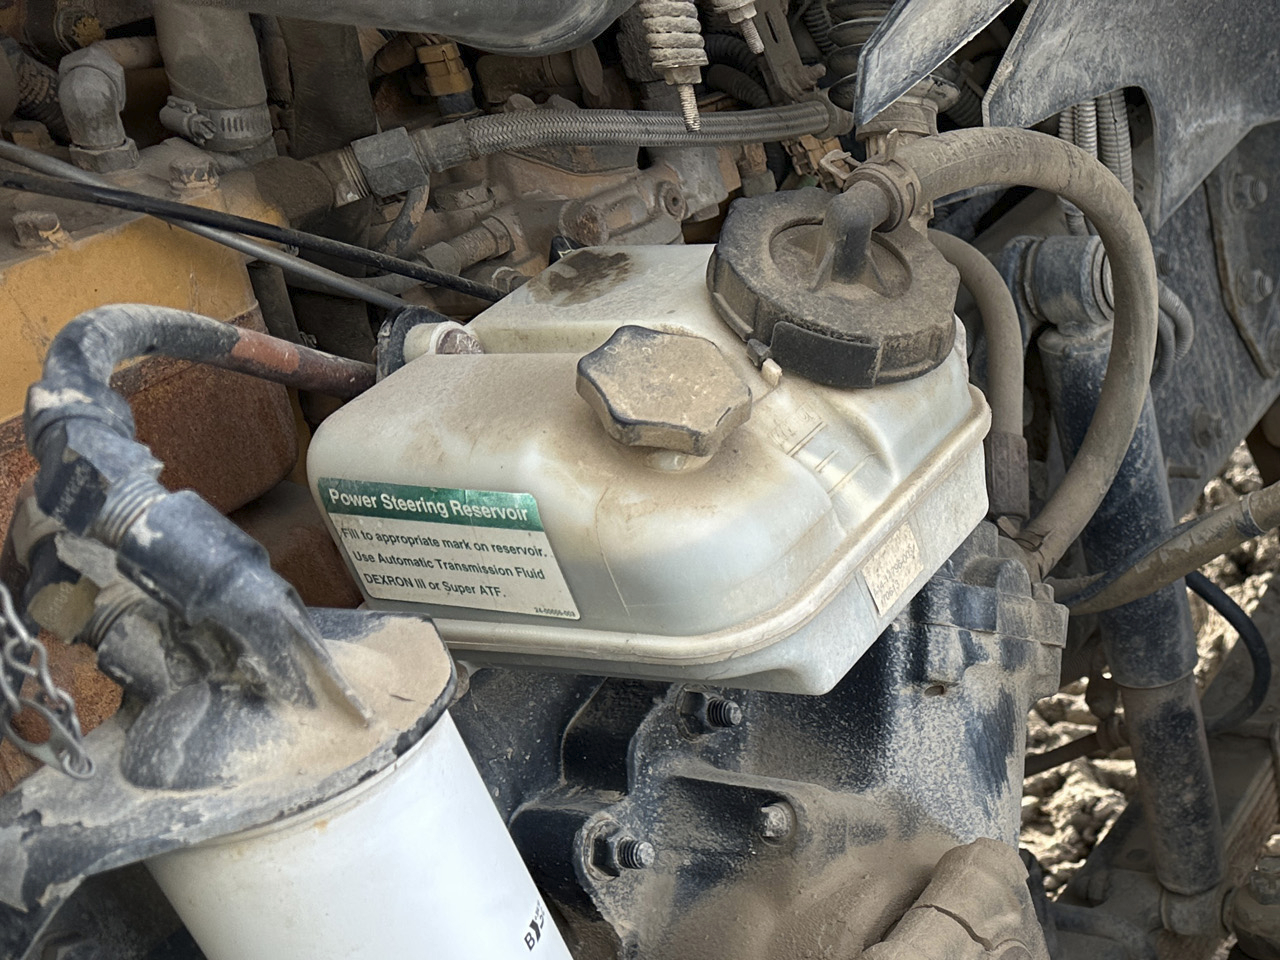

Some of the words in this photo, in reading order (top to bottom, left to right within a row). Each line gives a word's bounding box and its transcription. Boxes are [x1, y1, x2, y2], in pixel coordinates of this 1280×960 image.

[328, 488, 377, 508] Power
[380, 493, 449, 518] Steering
[449, 500, 528, 521] Reservoir
[341, 528, 360, 540] Fill
[360, 530, 374, 541] to
[375, 533, 440, 547] appropriate
[441, 539, 472, 551] mark
[473, 542, 490, 552] on
[491, 544, 548, 558] reservoir.
[352, 551, 376, 563] Use
[378, 553, 435, 568] Automatic
[434, 559, 514, 577] Transmission
[514, 566, 546, 580] Fluid
[363, 573, 415, 588] DEXRON
[414, 579, 427, 590] III
[428, 581, 441, 591] or
[441, 581, 476, 596] Super
[479, 585, 507, 598] ATF.
[524, 931, 536, 952] B
